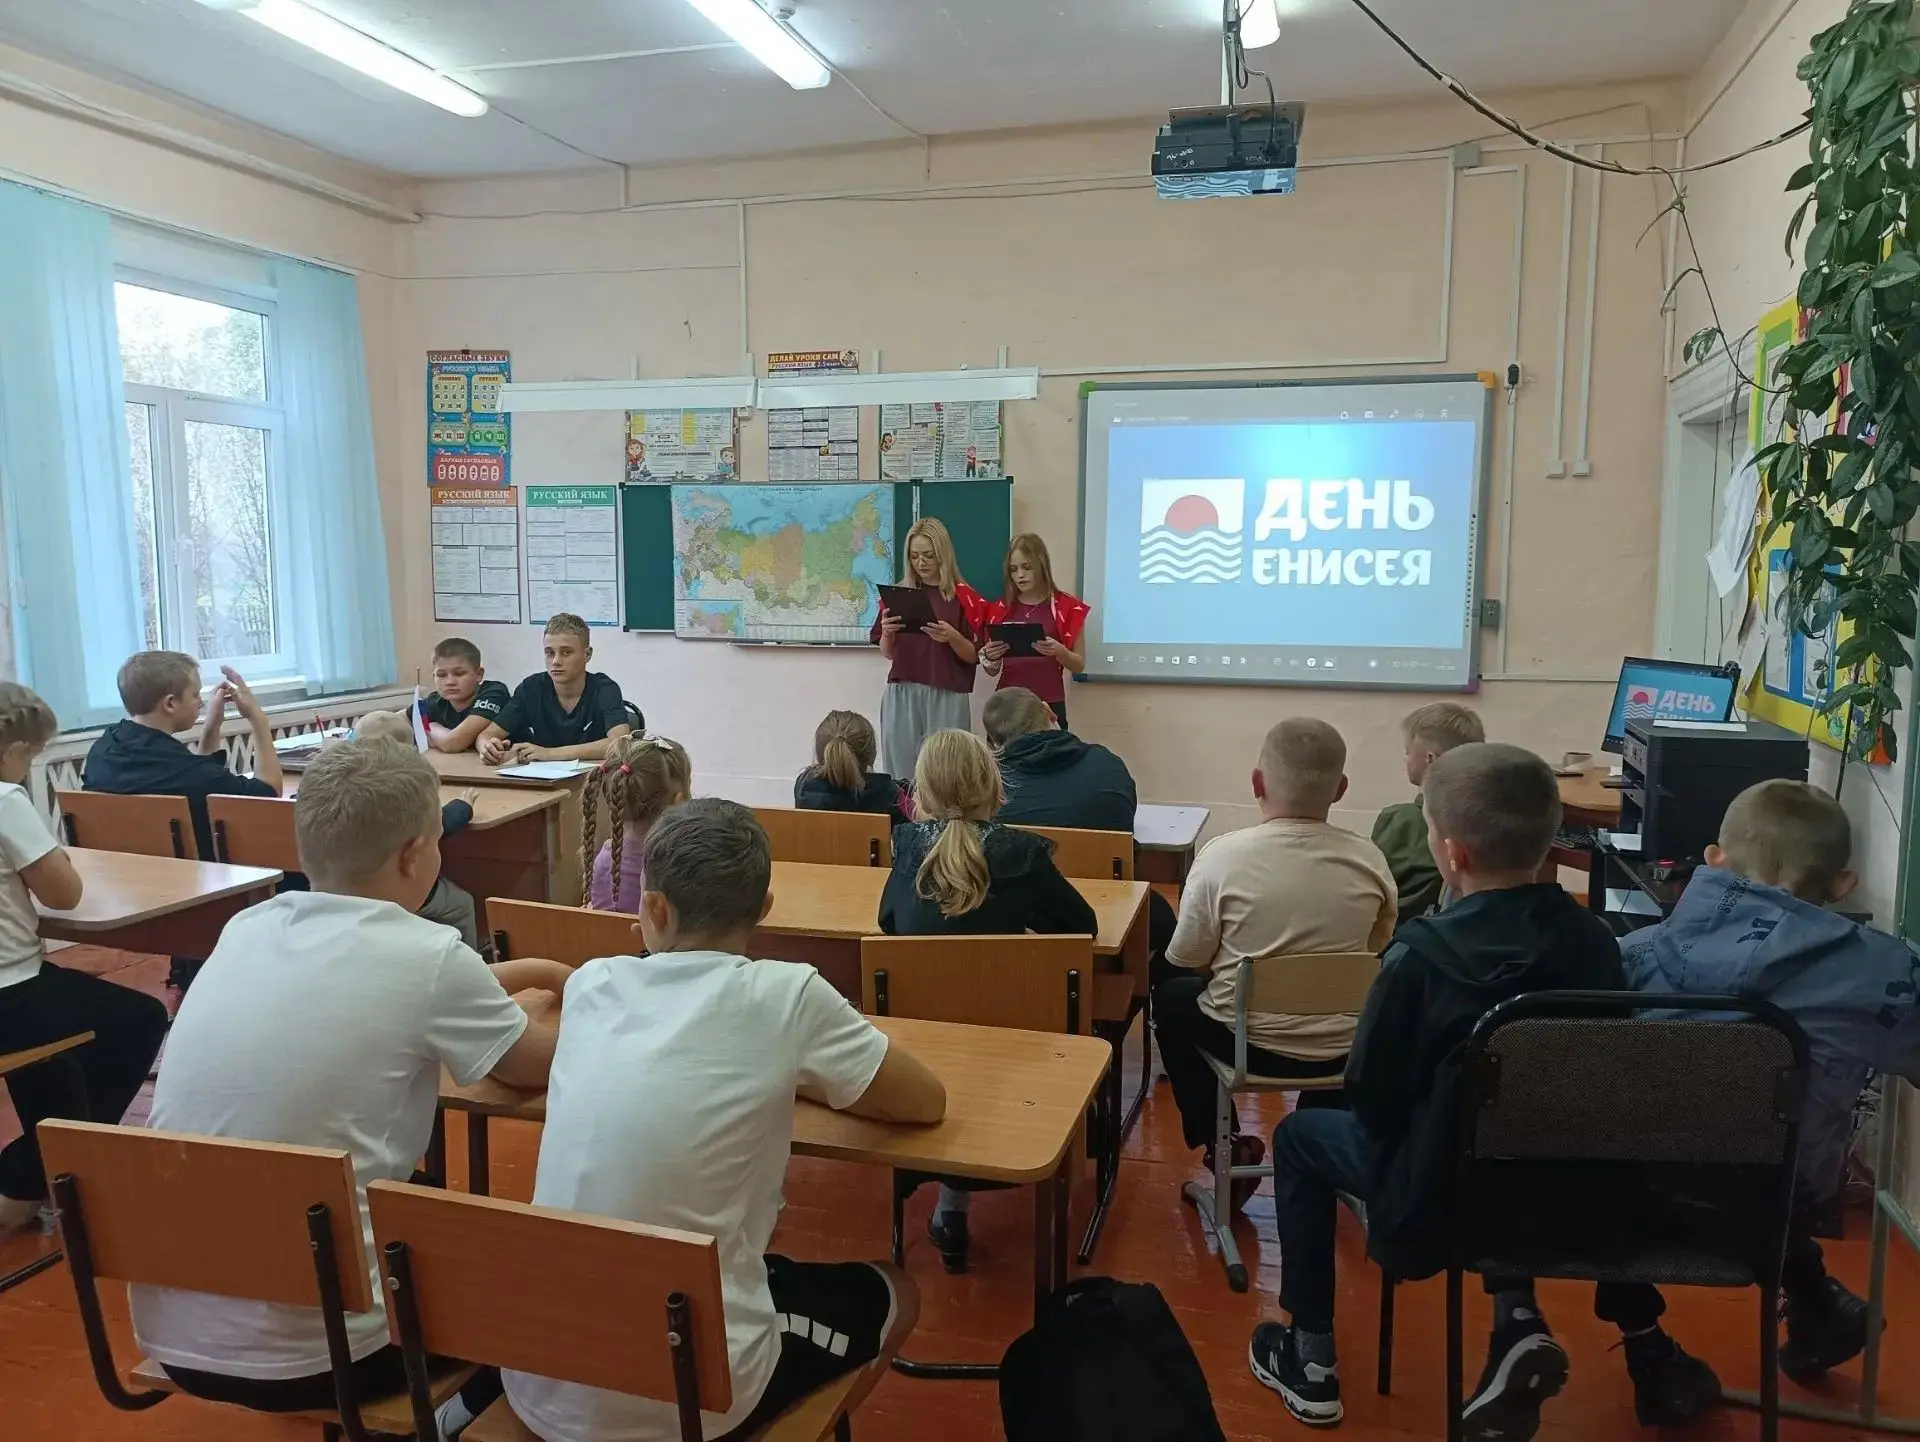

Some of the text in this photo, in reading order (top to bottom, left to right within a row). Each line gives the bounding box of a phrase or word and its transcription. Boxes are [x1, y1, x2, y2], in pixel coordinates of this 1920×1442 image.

[770, 354, 794, 362] ДЕЛАЙ
[438, 489, 510, 499] РУССКИЙ ЯЗЫК
[533, 490, 608, 499] РУССКИЙ ЯЗЫК
[1254, 478, 1435, 542] ДЕНЬ
[1252, 549, 1432, 586] ЕНИСЕЯ
[1658, 690, 1716, 714] ДЕНЬ
